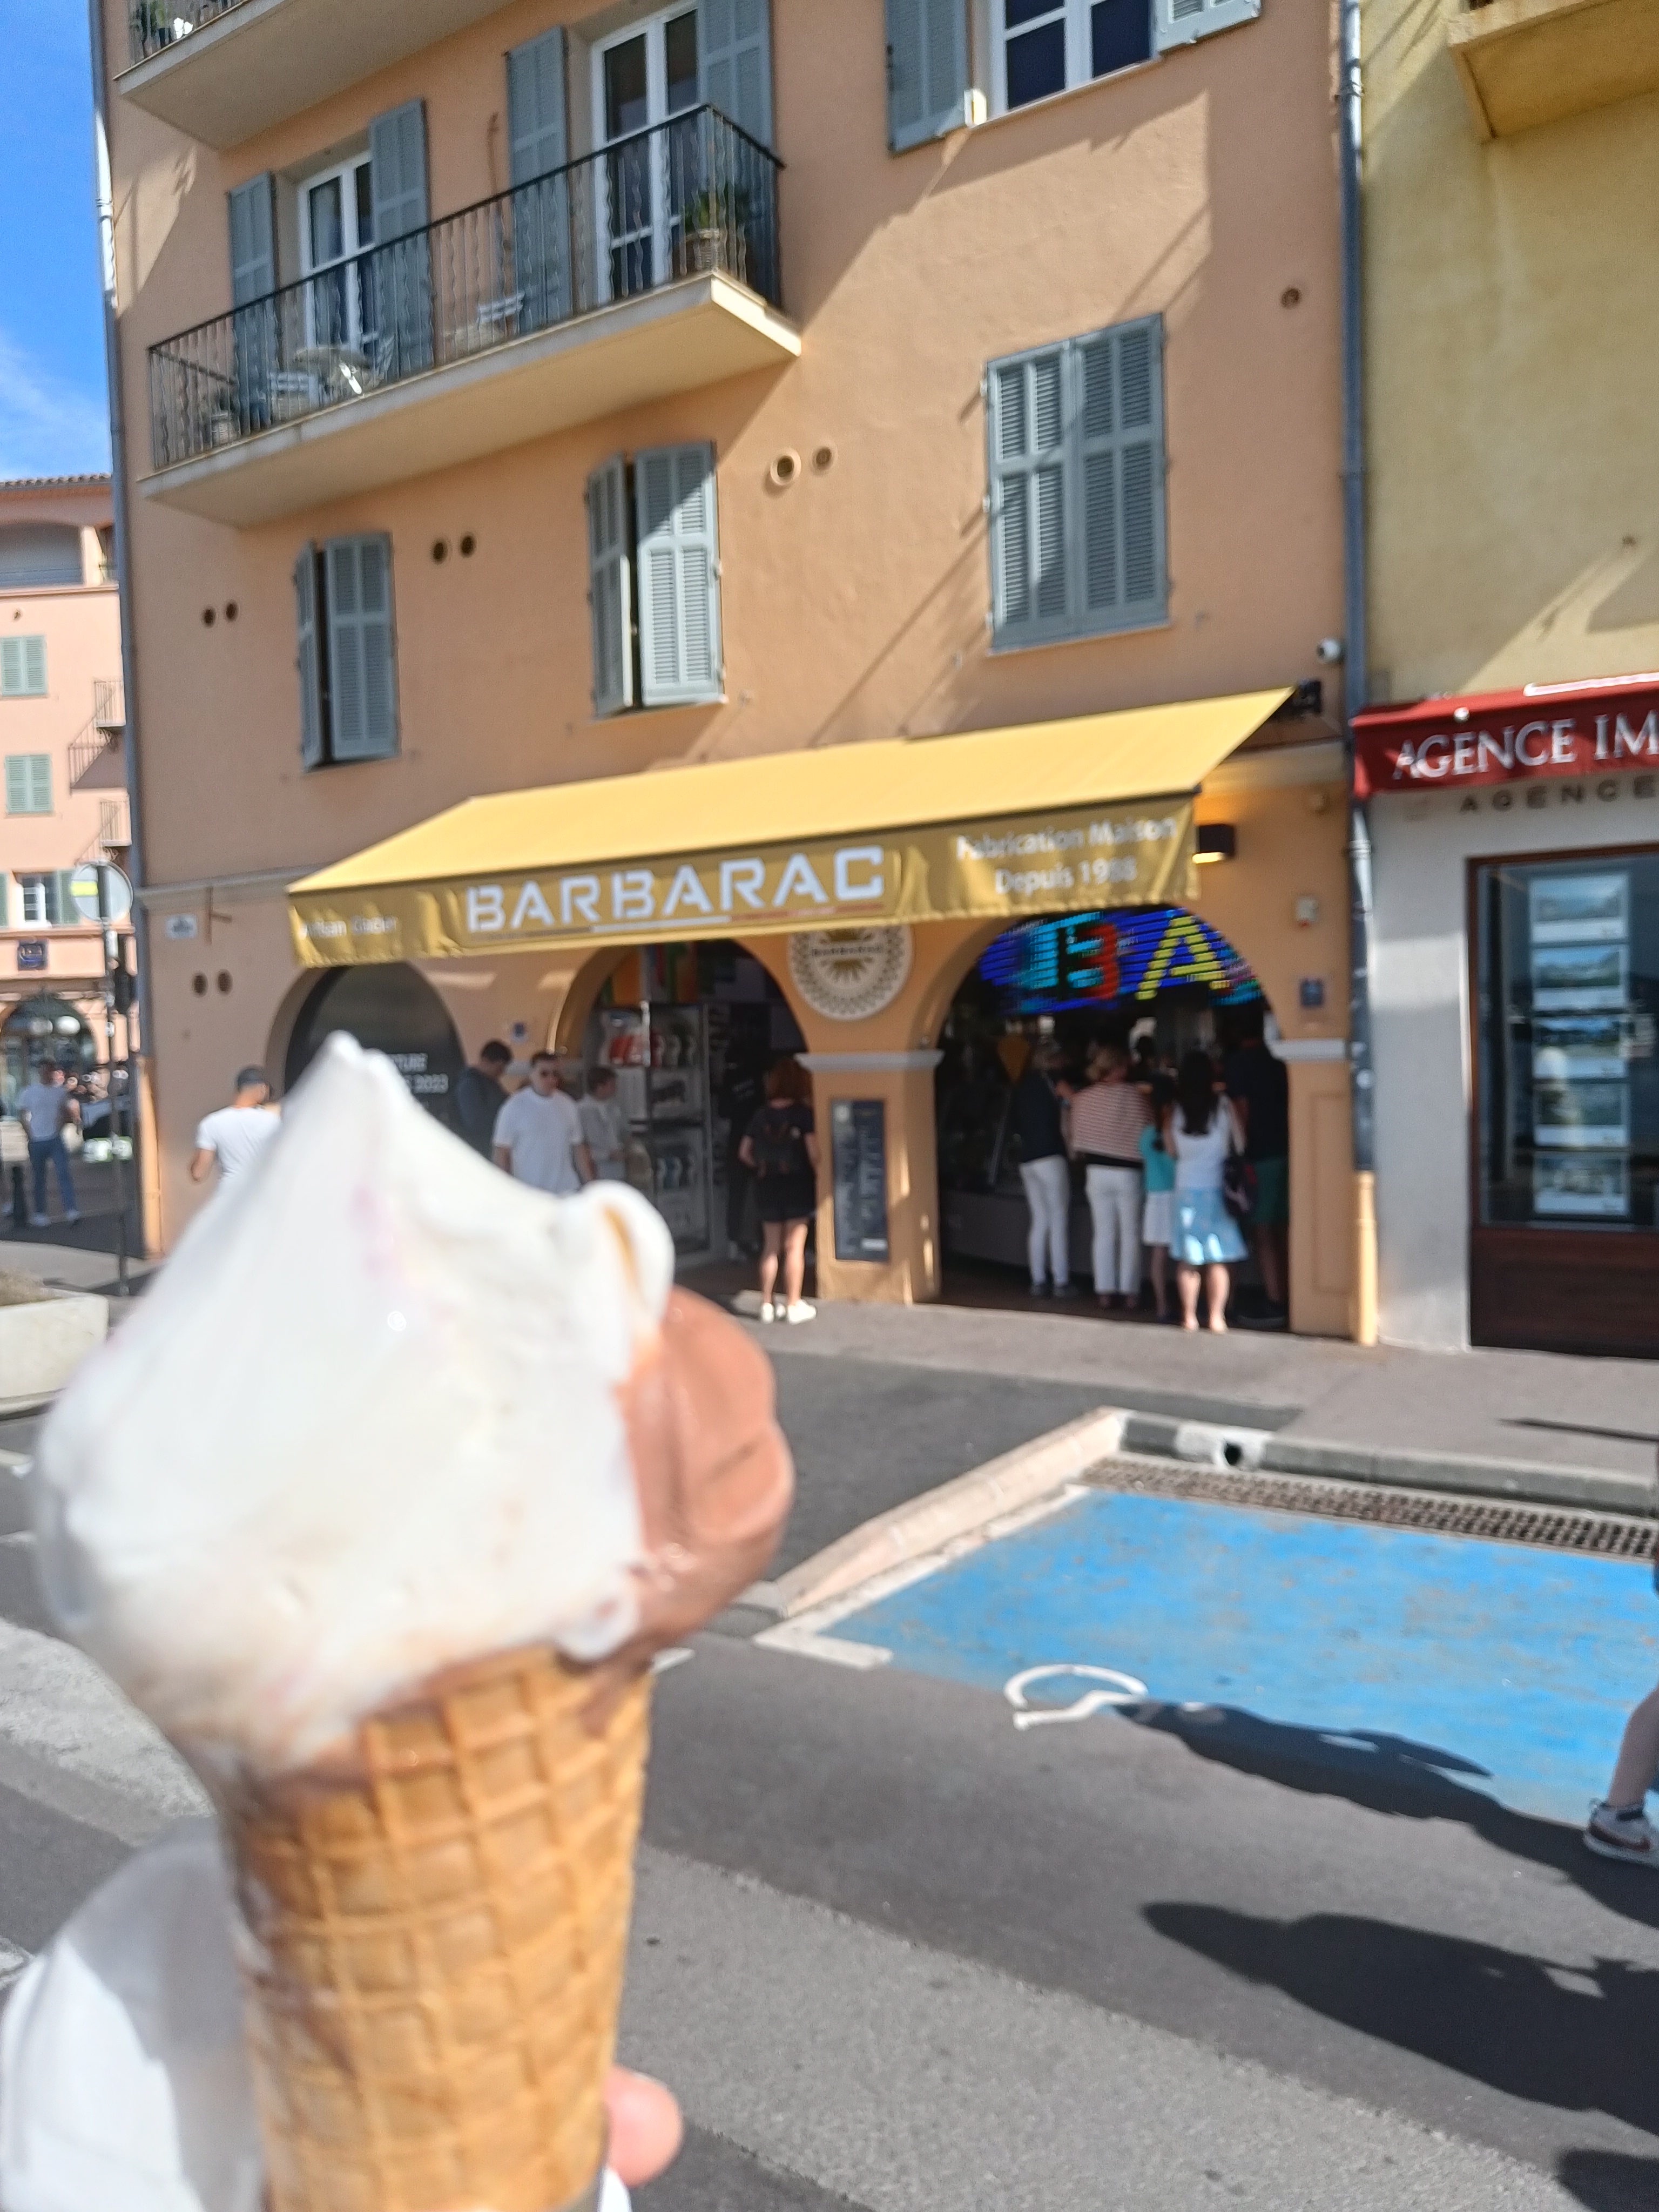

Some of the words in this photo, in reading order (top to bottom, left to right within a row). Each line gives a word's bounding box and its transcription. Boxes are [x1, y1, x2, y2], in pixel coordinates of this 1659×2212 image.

[1392, 718, 1576, 781] AGENCE
[1593, 710, 1659, 760] IM
[956, 823, 1084, 861] Fabrication
[1089, 816, 1177, 846] Maison
[466, 845, 885, 934] BARBARAC
[995, 863, 1075, 896] Depuis
